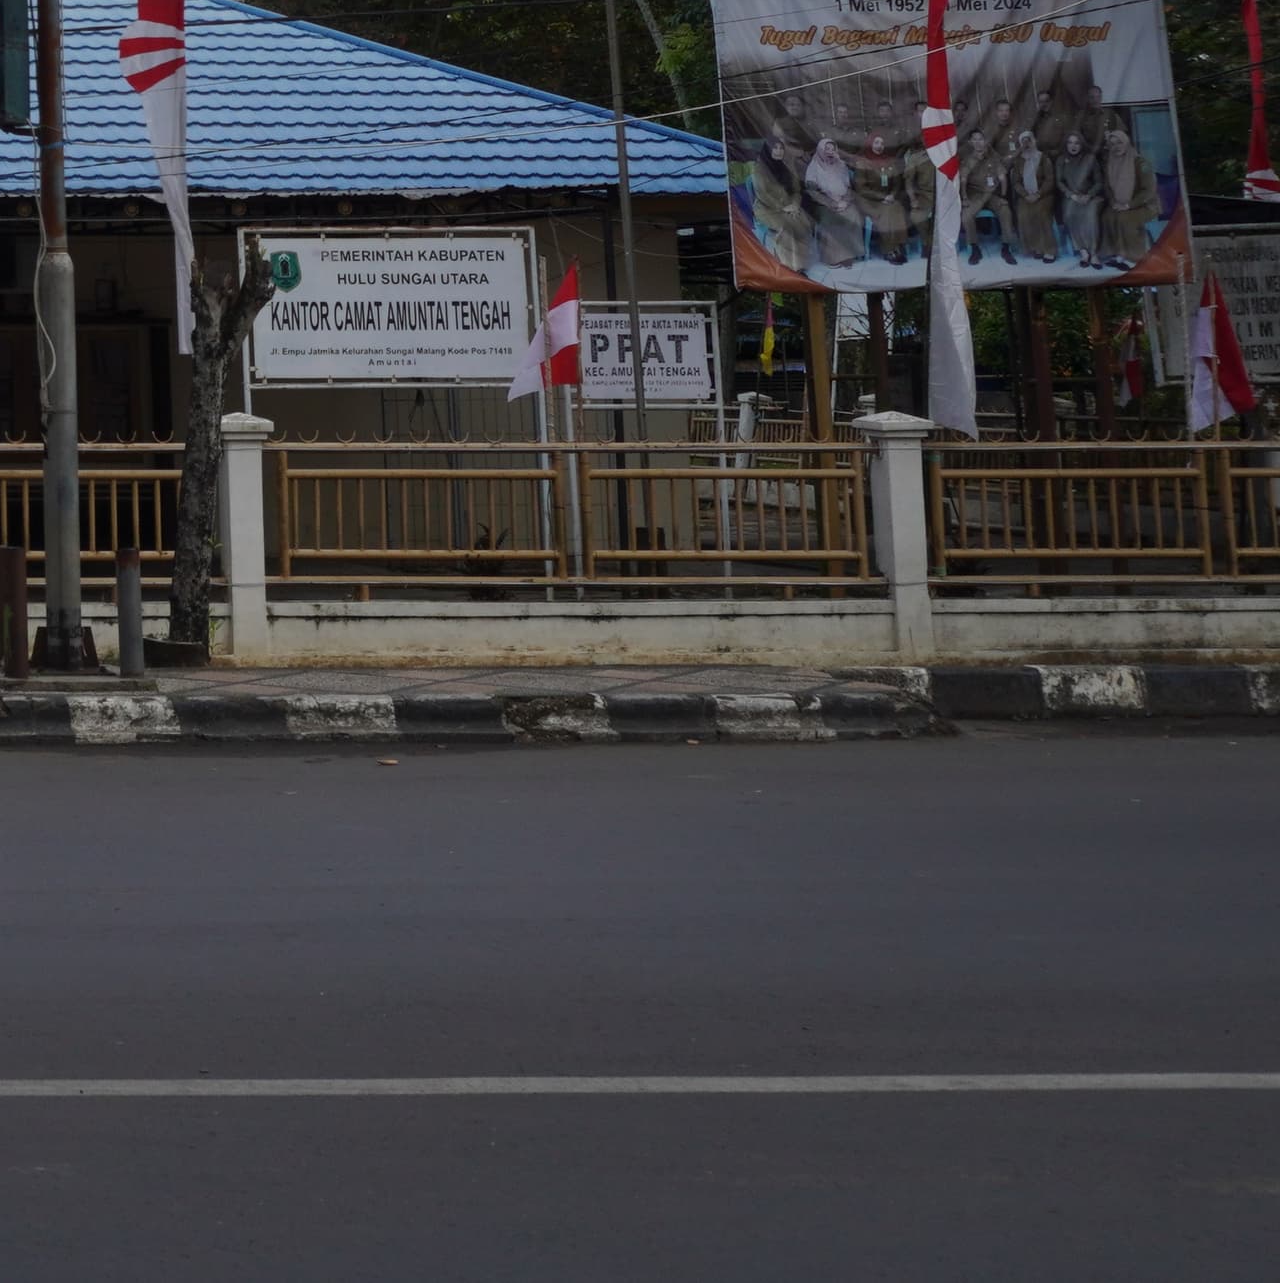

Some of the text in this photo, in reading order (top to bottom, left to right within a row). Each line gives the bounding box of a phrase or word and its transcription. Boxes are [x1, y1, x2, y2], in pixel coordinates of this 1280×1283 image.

[321, 250, 505, 262] PEMERINTAH KABUPATEN
[337, 272, 490, 286] HULU SUNGAI UTARA
[271, 300, 511, 331] KANTOR CAMAT AMUNTAI TENGAH
[652, 319, 671, 330] AKTA
[674, 319, 700, 330] TANAH
[282, 348, 306, 357] Empu
[307, 347, 340, 356] Jatmika
[342, 347, 384, 356] Kelurahan
[386, 347, 415, 357] Sungai
[416, 347, 446, 357] Malang
[447, 347, 469, 356] Kode
[471, 347, 487, 356] Pos
[590, 333, 689, 364] PPAT
[584, 366, 701, 377] KEC. AMUTAI TENGAH
